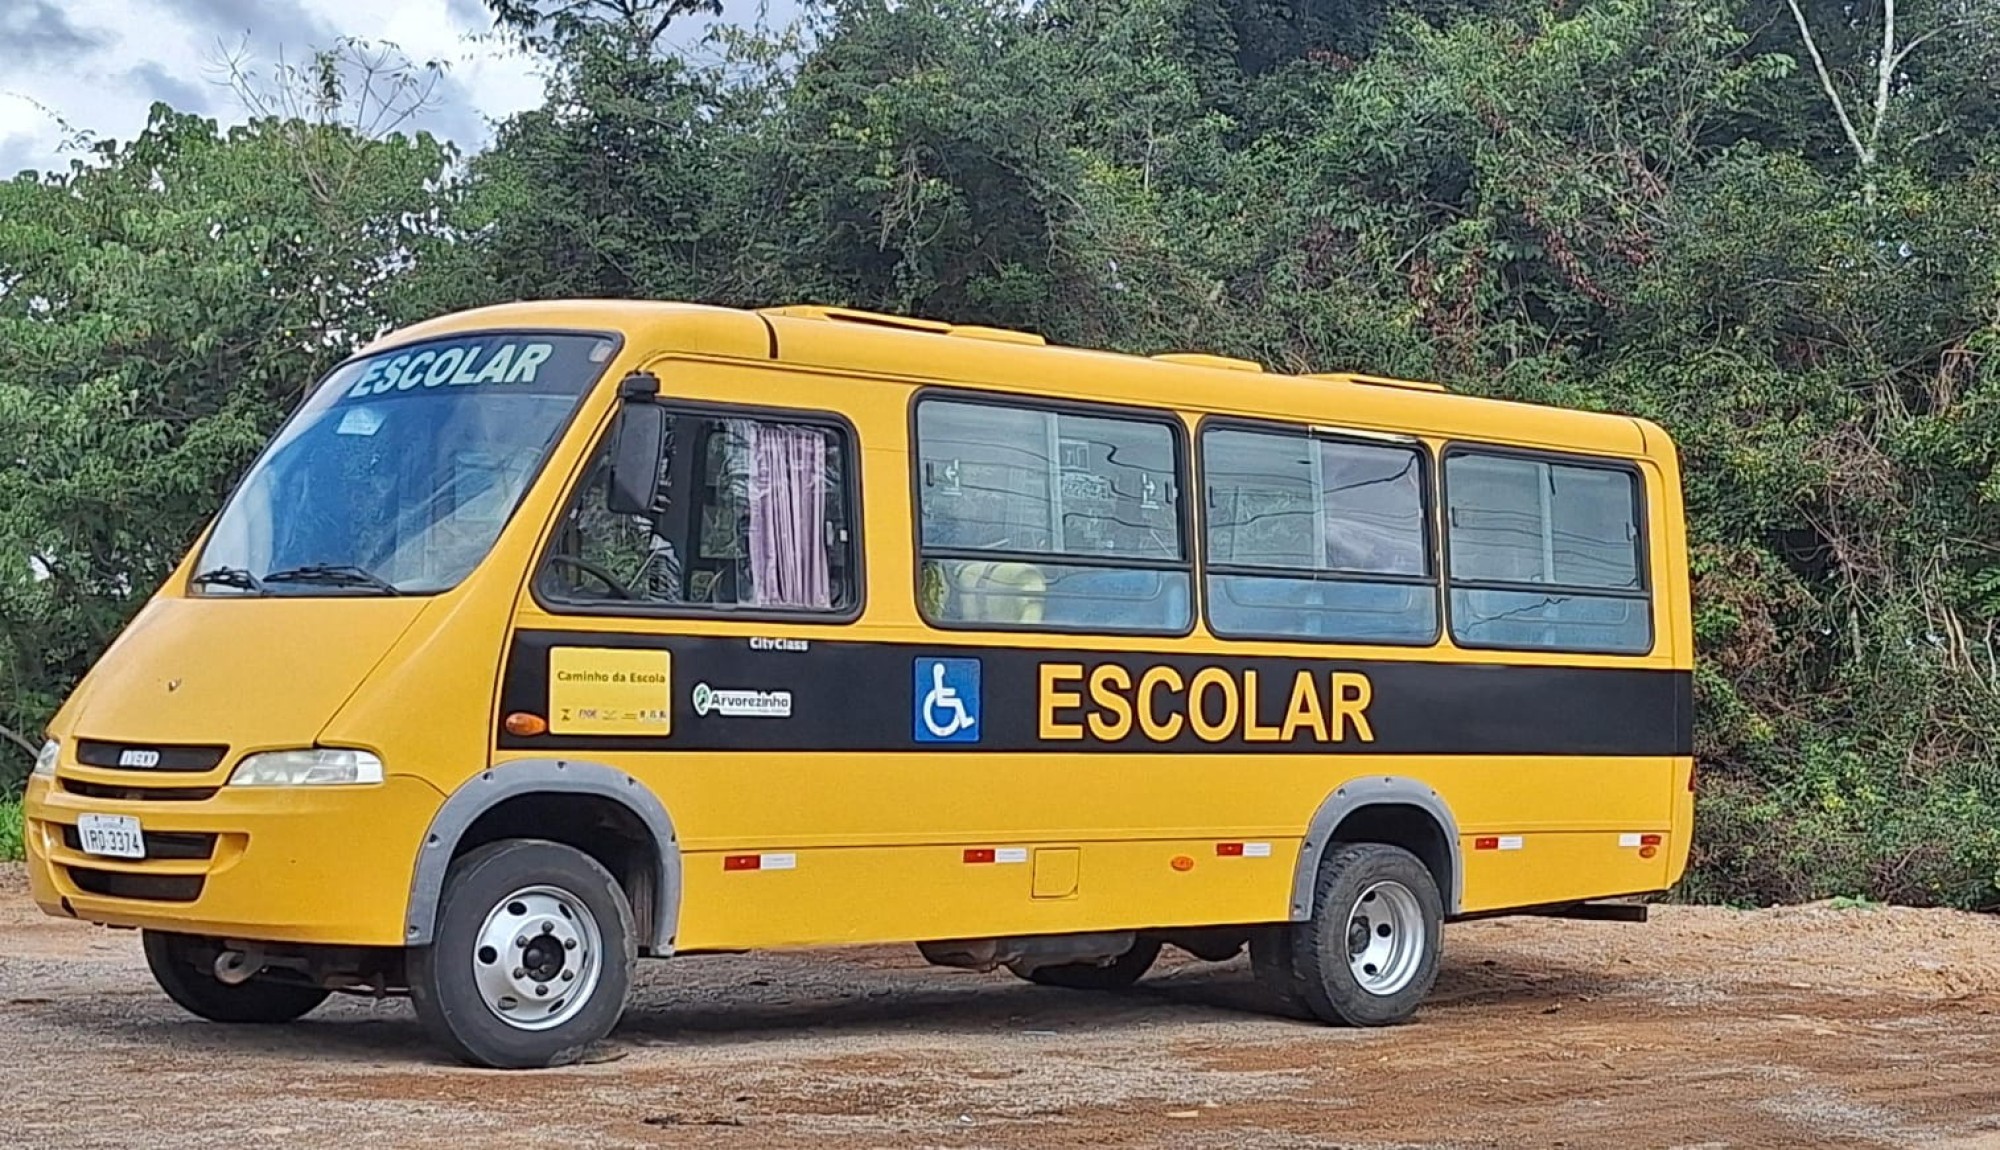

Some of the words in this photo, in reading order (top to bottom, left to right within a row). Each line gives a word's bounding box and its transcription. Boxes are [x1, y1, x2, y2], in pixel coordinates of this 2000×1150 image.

[348, 343, 553, 398] ESCOLAR
[749, 637, 808, 651] CityClass
[557, 670, 609, 683] Caminho
[612, 672, 626, 683] da
[630, 672, 666, 683] Escola
[1039, 664, 1374, 741] ESCOLAR
